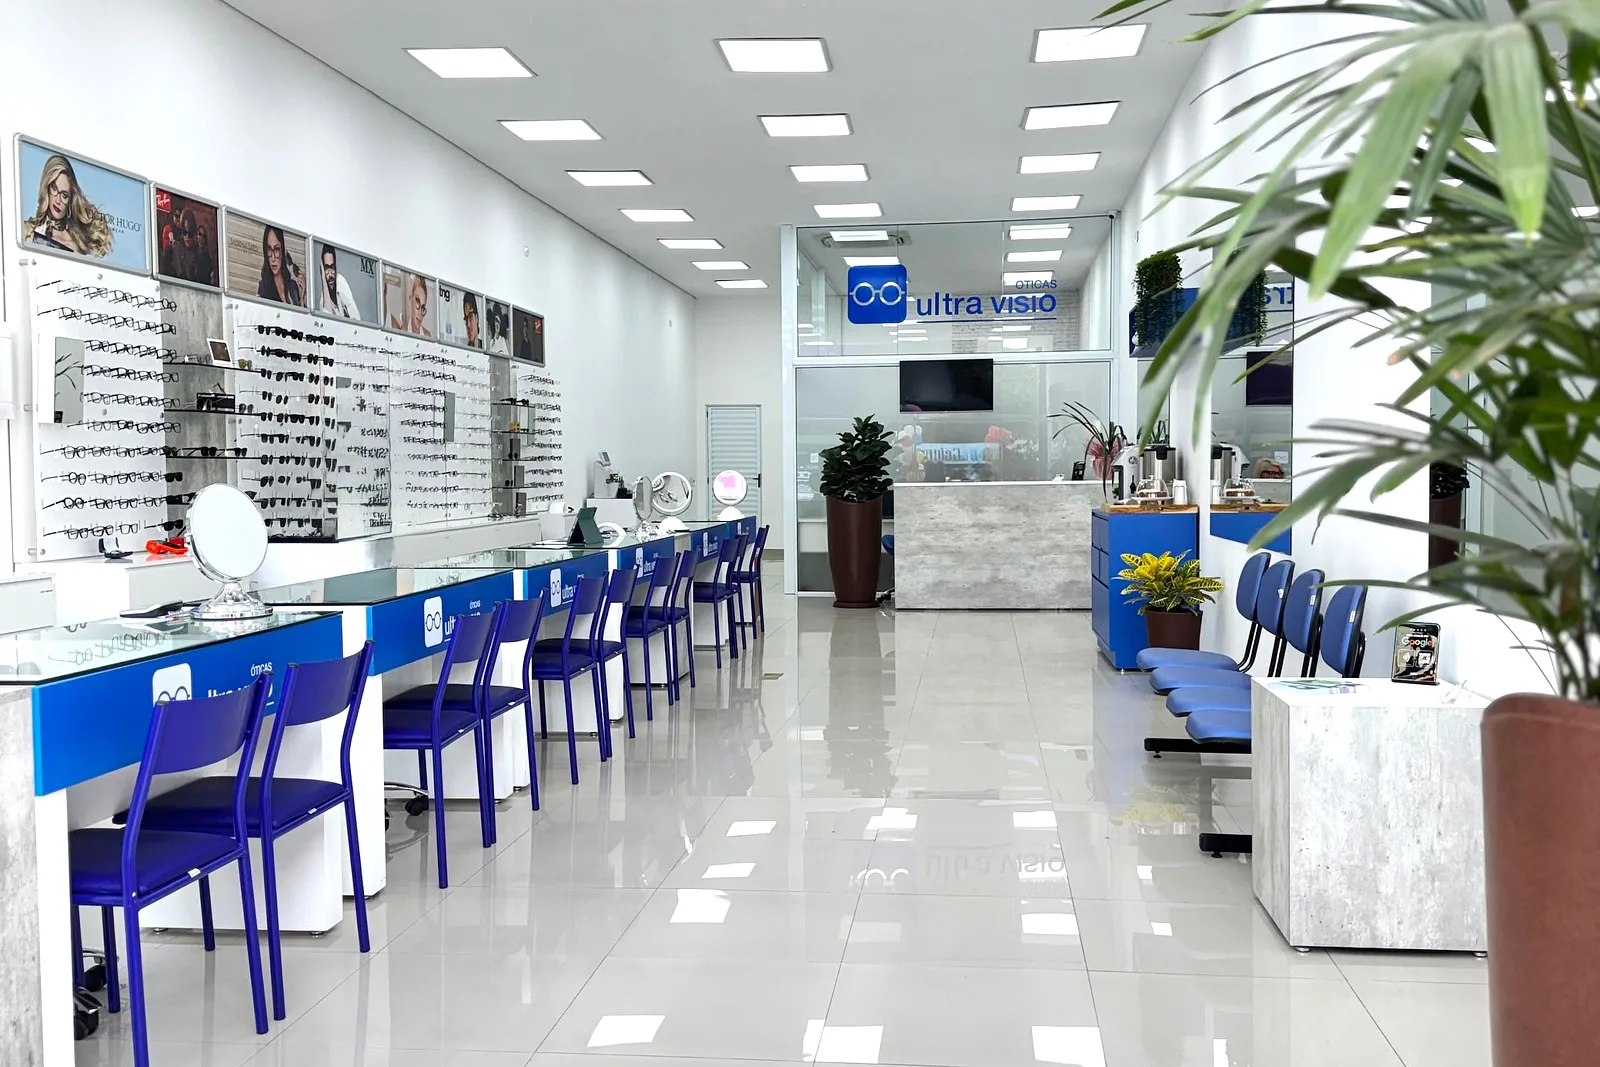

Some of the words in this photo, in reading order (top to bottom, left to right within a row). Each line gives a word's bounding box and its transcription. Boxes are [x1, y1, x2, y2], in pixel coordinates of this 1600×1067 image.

[116, 216, 141, 232] HUGO
[360, 258, 375, 275] MX
[439, 285, 451, 303] tng
[916, 292, 984, 317] ultra
[1401, 636, 1433, 648] Google
